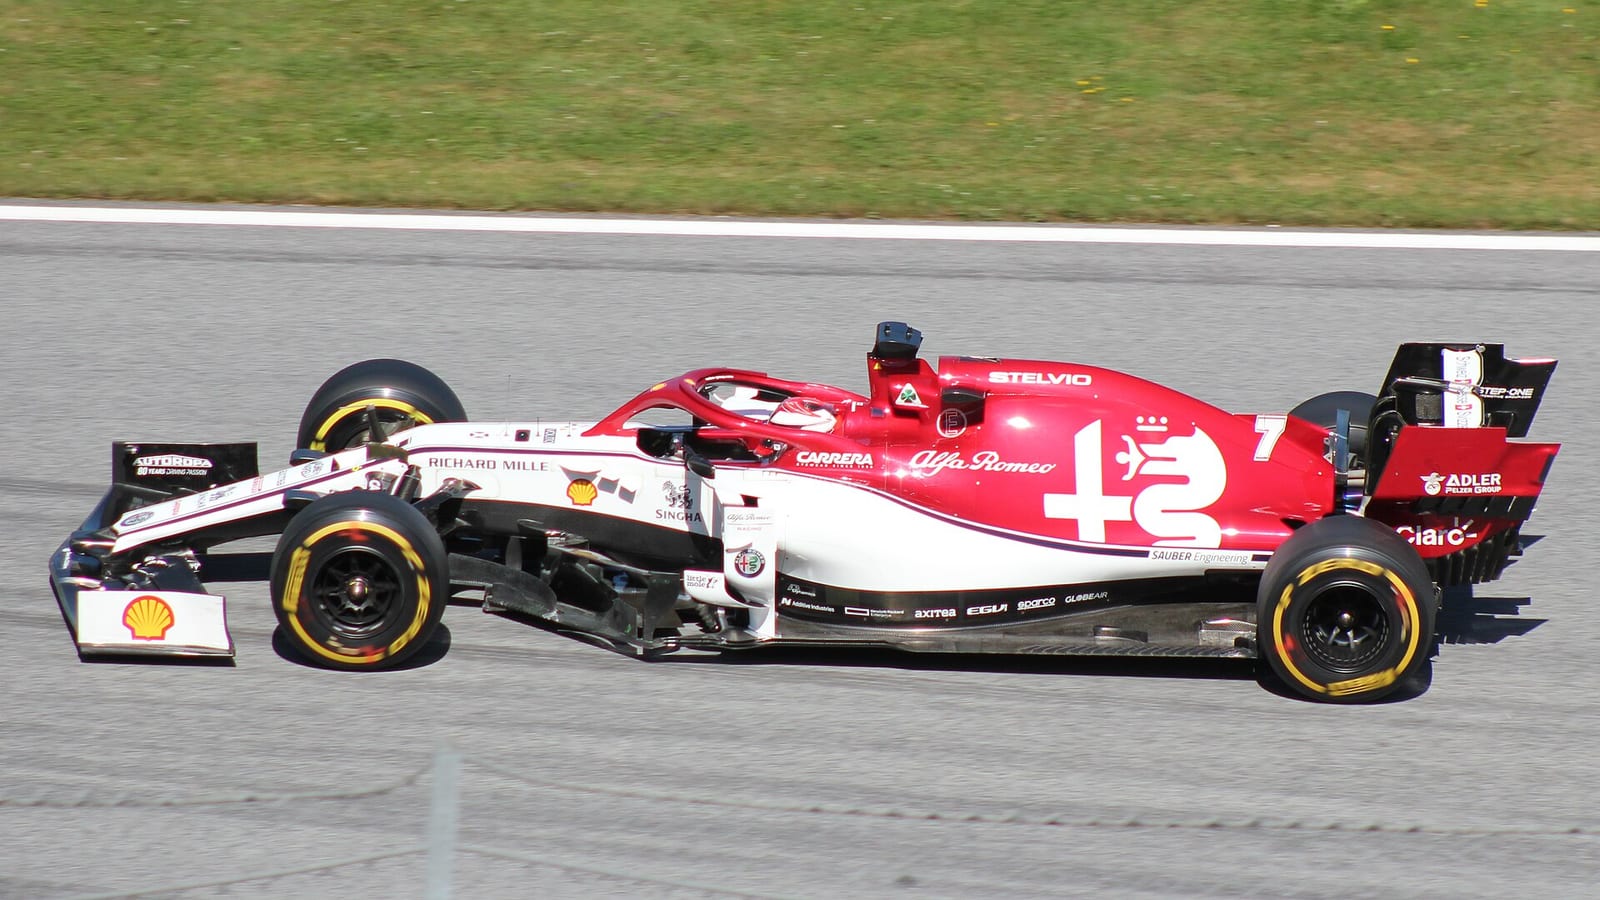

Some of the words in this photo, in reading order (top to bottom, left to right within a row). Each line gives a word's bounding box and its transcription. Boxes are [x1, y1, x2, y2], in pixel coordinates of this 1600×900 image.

[988, 371, 1092, 386] STELVIO
[1253, 415, 1288, 462] 7
[133, 454, 213, 468] AUTOROPA
[429, 457, 496, 470] RICHARD
[503, 460, 548, 471] MILLE
[796, 451, 873, 465] CARRERA
[910, 450, 969, 477] Alfa
[969, 450, 1056, 474] Romeo
[1446, 473, 1502, 487] ADLER
[656, 509, 702, 522] SINGHA
[1396, 525, 1465, 546] Claro
[1152, 550, 1192, 561] SAUBER
[1193, 552, 1248, 565] Engineering
[1017, 597, 1056, 610] sparco
[1065, 591, 1108, 604] GLOBEAIR
